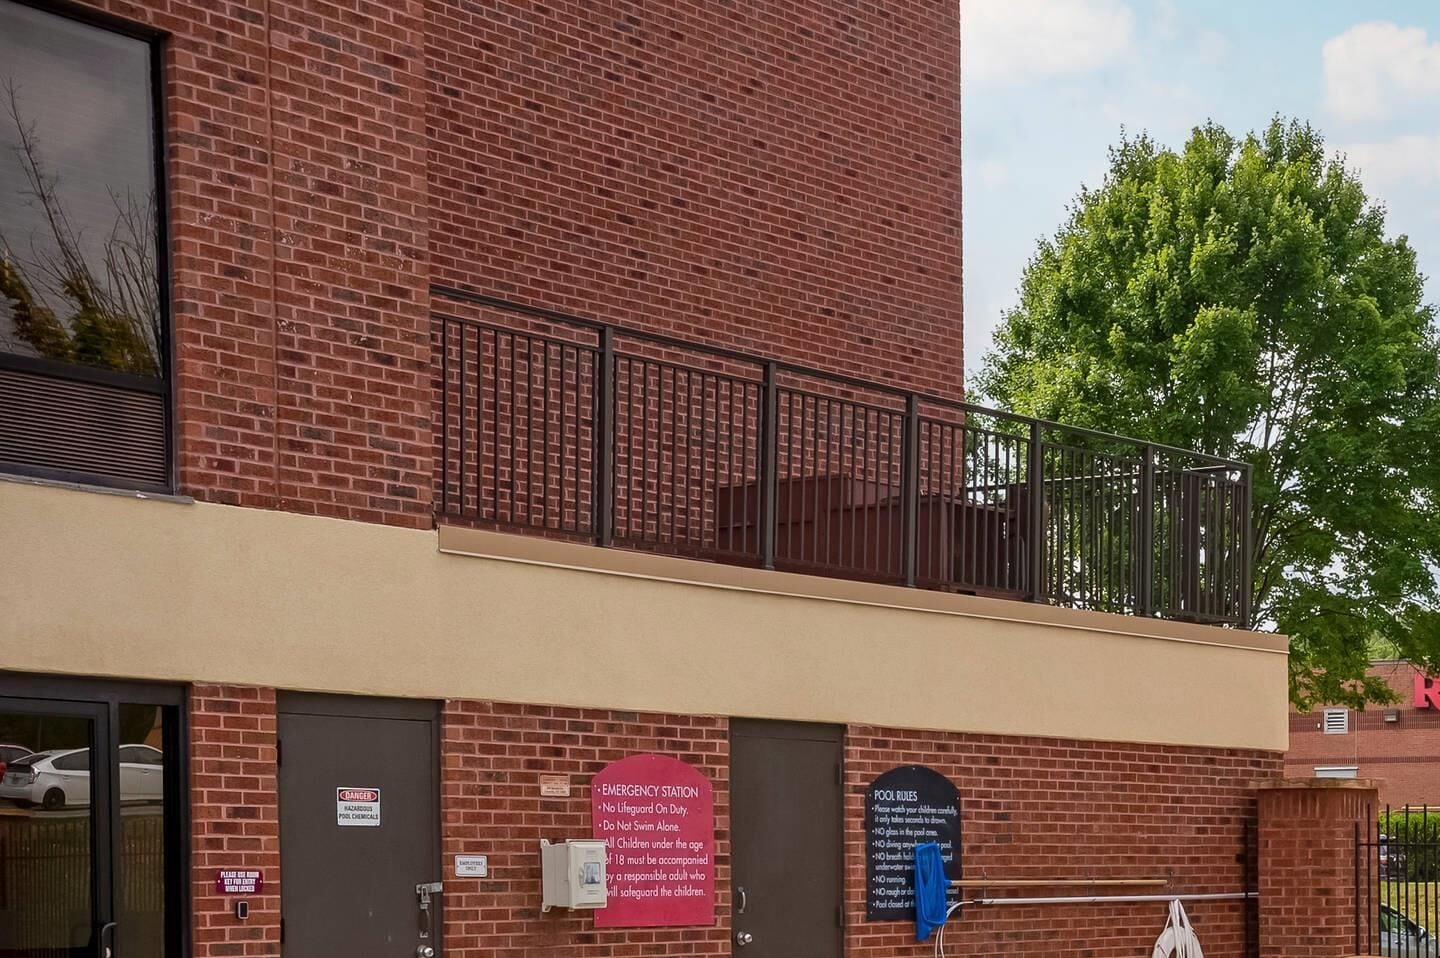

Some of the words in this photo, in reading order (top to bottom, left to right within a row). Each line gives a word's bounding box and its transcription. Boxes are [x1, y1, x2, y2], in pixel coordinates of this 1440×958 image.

[345, 791, 371, 800] DANGER
[602, 783, 659, 797] EMERGENCY
[661, 785, 699, 798] STATION
[874, 790, 895, 801] POOL
[896, 791, 918, 802] RULES
[602, 802, 615, 813] No
[617, 801, 653, 816] Lifeguard
[655, 803, 668, 814] On
[670, 804, 689, 817] Duty.
[874, 804, 890, 813] Please
[891, 804, 905, 813] watch
[906, 807, 917, 816] your
[918, 804, 937, 814] children
[880, 815, 890, 825] only
[891, 815, 904, 824] takes
[905, 815, 924, 824] seconds
[924, 816, 930, 824] to
[603, 820, 615, 830] Do
[617, 820, 631, 831] Not
[634, 820, 654, 831] Swim
[656, 820, 681, 832] Alone.
[875, 827, 885, 836] NO
[886, 827, 899, 838] glass
[899, 827, 904, 836] in
[905, 827, 913, 836] the
[914, 827, 925, 838] pool
[617, 837, 649, 849] Children
[651, 837, 674, 849] under
[675, 837, 687, 849] the
[689, 841, 704, 853] age
[875, 840, 886, 848] NO
[886, 840, 902, 850] diving
[615, 853, 625, 866] 18
[627, 854, 645, 865] must
[647, 853, 657, 865] be
[658, 853, 709, 867] accompanied
[875, 852, 886, 860] NO
[886, 852, 902, 860] breath
[875, 862, 904, 871] underwater
[616, 873, 622, 881] a
[624, 869, 667, 884] responsible
[669, 868, 688, 881] adult
[689, 868, 706, 881] who
[875, 875, 886, 883] NO
[620, 885, 659, 900] safeguard
[660, 885, 672, 897] the
[674, 884, 706, 897] children.
[875, 887, 886, 896] NO
[886, 887, 900, 897] rough
[876, 899, 887, 908] Pool
[888, 899, 904, 908] closed
